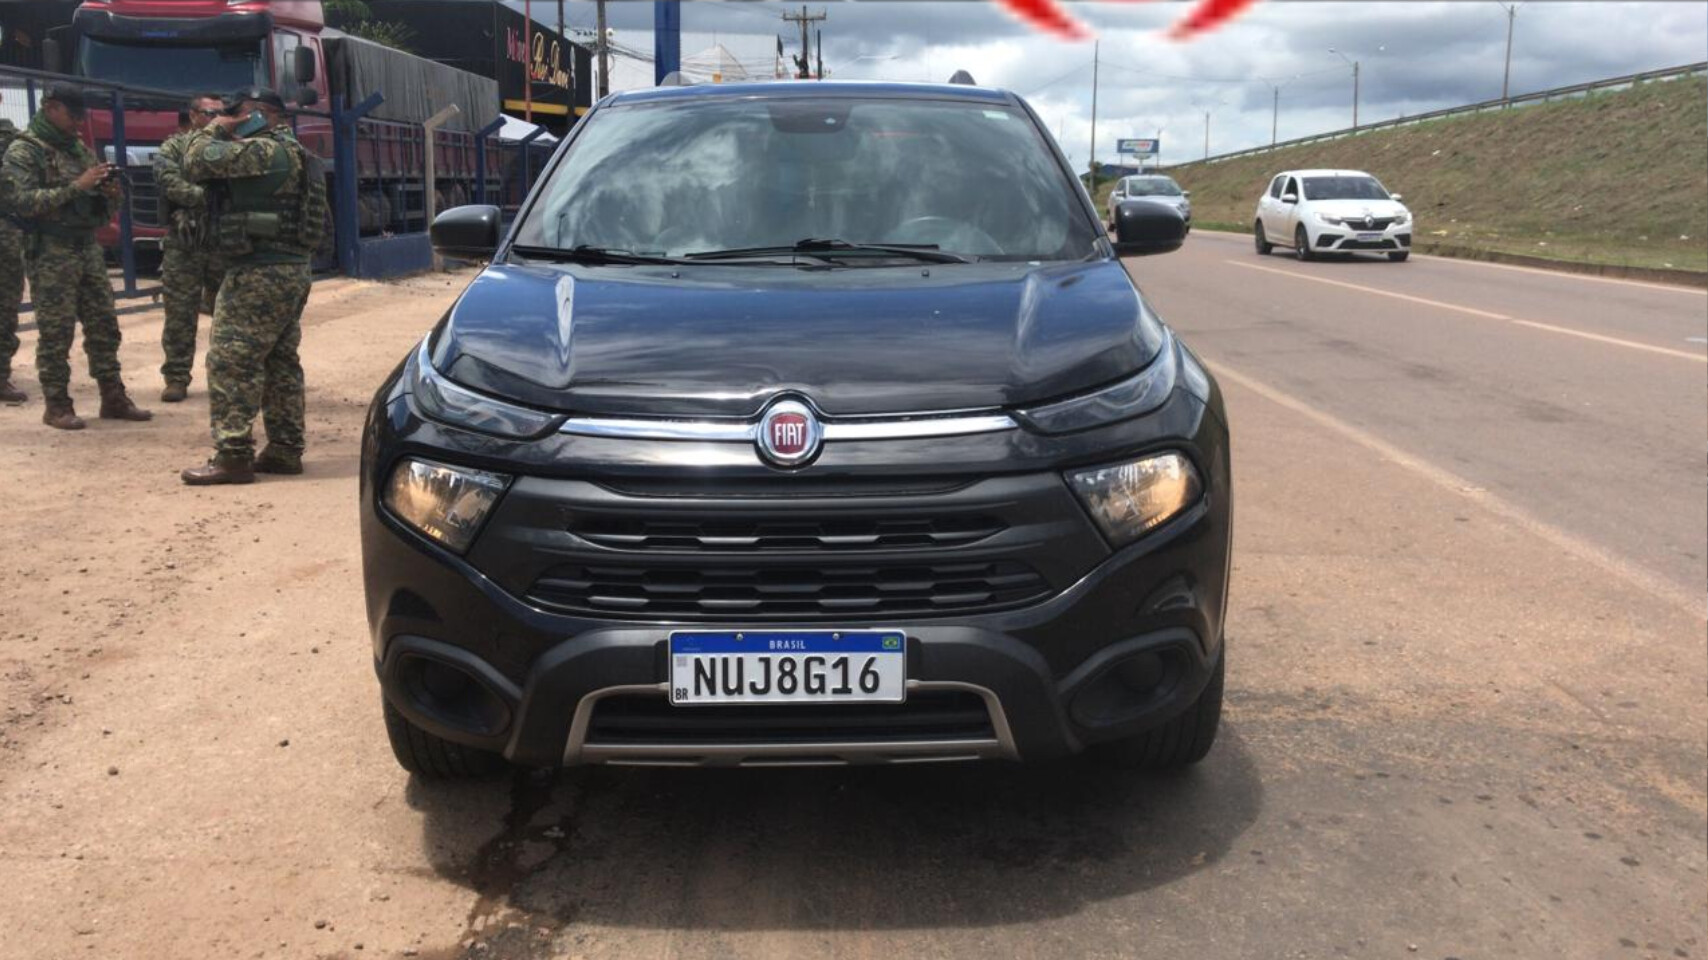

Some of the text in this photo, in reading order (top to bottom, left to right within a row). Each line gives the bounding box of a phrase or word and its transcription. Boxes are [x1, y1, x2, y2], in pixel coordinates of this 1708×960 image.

[774, 423, 804, 446] FIAT
[769, 640, 806, 650] BRASIL
[694, 656, 880, 696] NUJ8G16
[675, 689, 688, 700] BR
